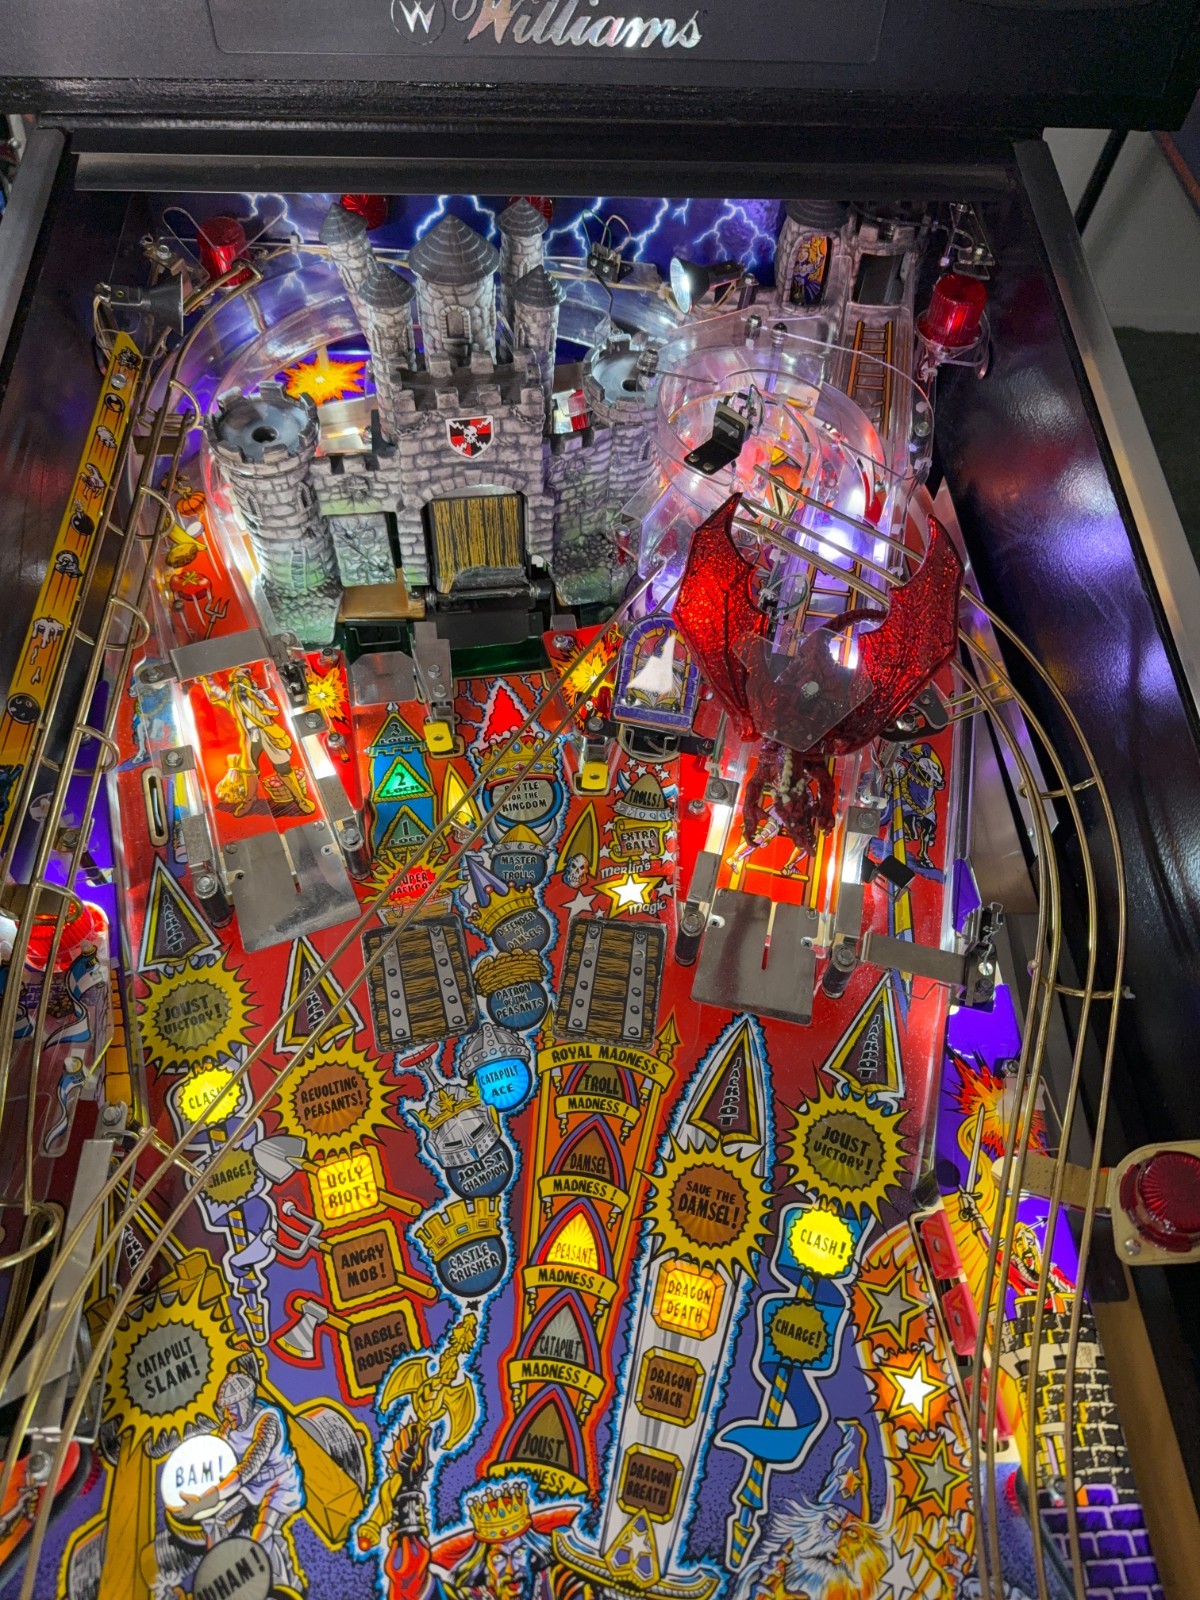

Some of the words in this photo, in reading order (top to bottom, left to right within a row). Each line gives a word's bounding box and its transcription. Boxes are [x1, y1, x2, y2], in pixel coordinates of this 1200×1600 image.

[451, 0, 704, 48] Williams
[380, 736, 417, 745] LOCK
[389, 722, 401, 736] 3
[386, 785, 421, 795] LOCK
[394, 772, 407, 787] 2
[504, 781, 540, 794] BTTLE
[502, 799, 548, 813] KINGDOM
[524, 791, 539, 800] THE
[630, 788, 661, 808] TROLLS!
[390, 835, 427, 846] LOCK
[402, 820, 410, 837] 1
[620, 830, 658, 843] EXTRA
[625, 839, 656, 850] BALL
[501, 855, 537, 865] MASTER
[513, 863, 524, 871] OF
[402, 872, 428, 885] UPER
[502, 870, 536, 881] TROLLS
[629, 898, 667, 916] magic
[163, 894, 186, 953] JACKPOT
[497, 912, 537, 937] DEFENDER
[515, 927, 525, 936] OF
[507, 925, 545, 950] DAMSELS
[495, 982, 533, 1000] PATRON
[503, 998, 513, 1007] OF
[515, 993, 528, 1004] THE
[163, 994, 210, 1022] JOUST
[163, 1004, 222, 1035] VICTORY!
[496, 998, 545, 1019] PEASANTS
[857, 1014, 881, 1078] JACKPOT
[552, 1046, 593, 1063] ROYAL
[598, 1045, 658, 1075] MADNESS
[480, 1065, 519, 1086] CATAPULT
[584, 1074, 619, 1095] TROLL
[188, 1086, 234, 1109] CLAS
[301, 1077, 358, 1104] REVOLTING
[491, 1083, 515, 1097] ACE
[717, 1057, 742, 1126] JACKPOT
[303, 1092, 363, 1121] PEASANTS!
[822, 1126, 870, 1156] JOUST
[458, 1149, 504, 1183] JOUST
[570, 1152, 608, 1175] DAMSEL
[813, 1141, 873, 1176] VICTORY!
[208, 1159, 252, 1188] HARGE!
[327, 1166, 363, 1189] UGLY
[462, 1162, 507, 1193] CHAMPION
[328, 1182, 371, 1208] RIOT!
[686, 1181, 712, 1196] SAVE
[716, 1189, 737, 1205] THE
[678, 1196, 740, 1229] DAMSEL!
[449, 1241, 489, 1269] CASTLE
[555, 1242, 594, 1266] PEASANT
[800, 1230, 846, 1260] CLASH!
[341, 1245, 384, 1270] ANGRY
[347, 1266, 386, 1287] MOB!
[448, 1256, 500, 1284] CRUSHER
[667, 1280, 711, 1305] DRAGON
[666, 1300, 702, 1323] DEATH
[354, 1321, 403, 1352] RABBLE
[775, 1319, 822, 1349] CHARGE!
[136, 1336, 193, 1378] CATAPULT
[538, 1335, 582, 1361] CATAPULT
[144, 1356, 200, 1398] SLAM!
[650, 1368, 692, 1392] DRAGON
[648, 1385, 682, 1409] SNACK
[522, 1433, 564, 1461] JOUST
[175, 1455, 224, 1488] BAM!
[629, 1462, 671, 1487] DRAGON
[626, 1478, 667, 1501] BREATH
